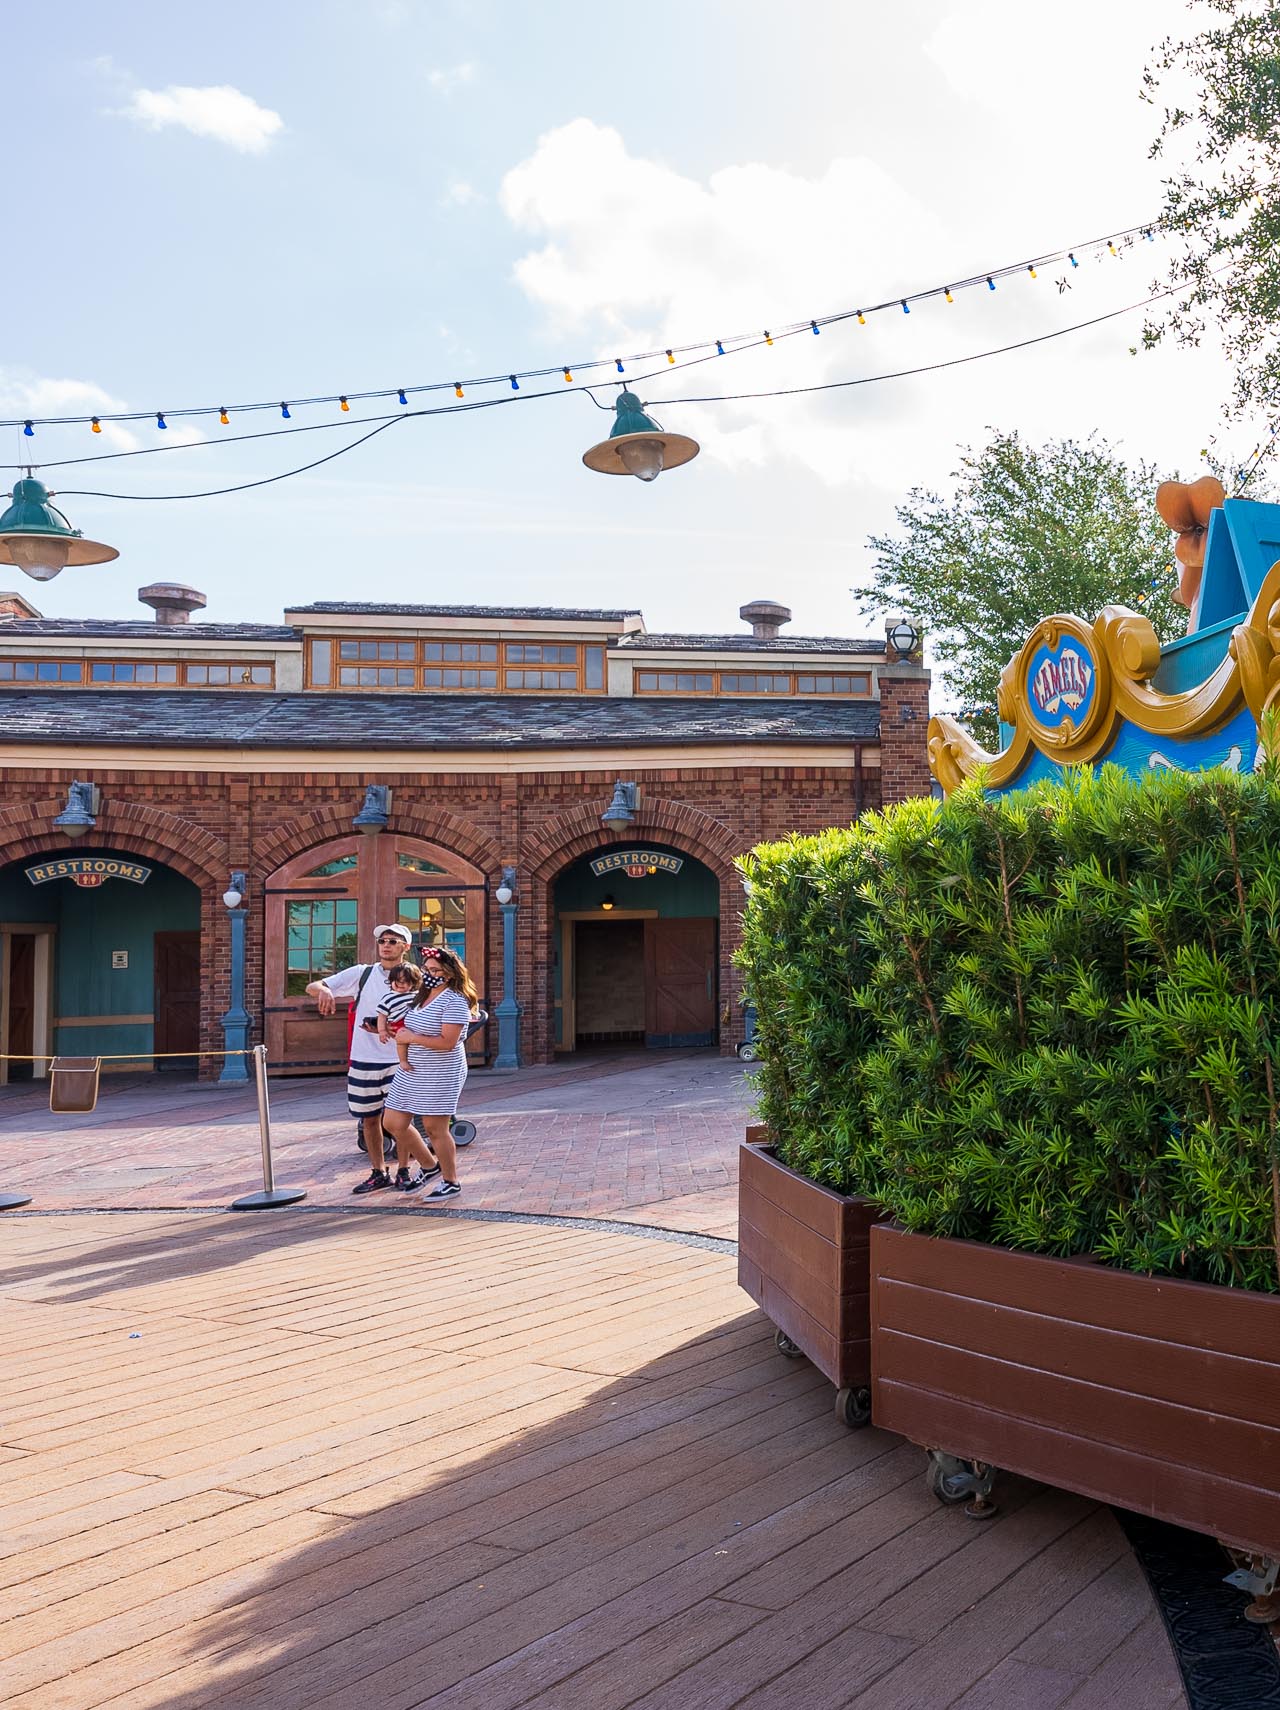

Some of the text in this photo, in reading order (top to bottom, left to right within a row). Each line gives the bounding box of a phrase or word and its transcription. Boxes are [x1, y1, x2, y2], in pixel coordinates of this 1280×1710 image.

[1033, 656, 1087, 710] CAMELS
[33, 861, 143, 880] RESTROOMS
[597, 853, 678, 871] RESTROOMS
